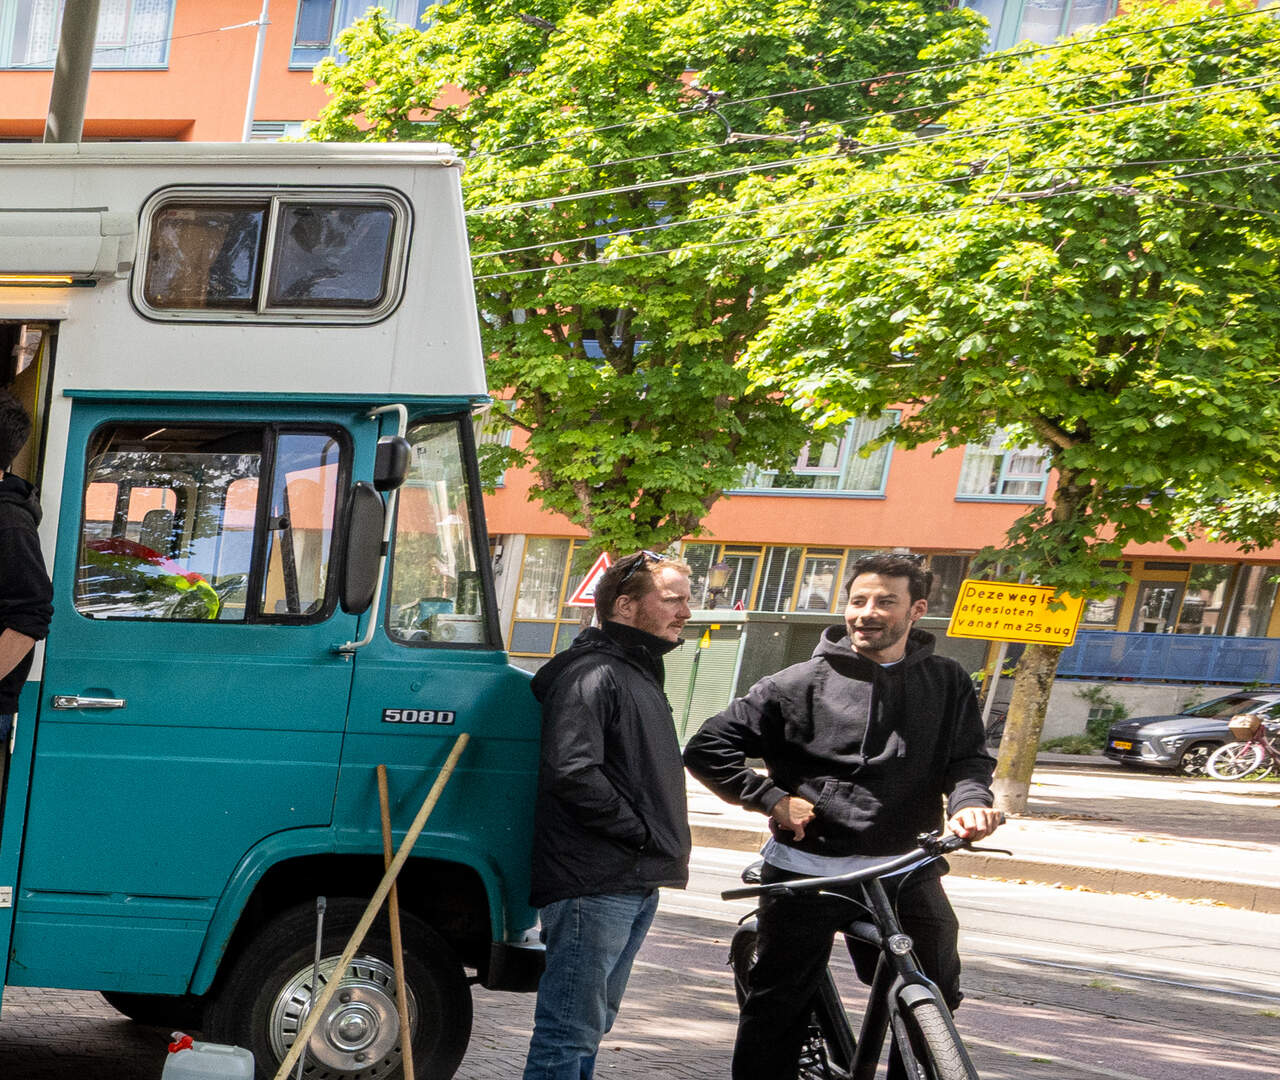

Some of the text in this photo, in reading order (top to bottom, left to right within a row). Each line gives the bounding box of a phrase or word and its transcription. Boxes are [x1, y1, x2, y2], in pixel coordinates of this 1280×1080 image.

[966, 587, 1004, 600] Deze
[1008, 593, 1036, 606] weg
[961, 603, 1034, 618] afgesloten
[958, 618, 1070, 637] vanaf ma 25 aug
